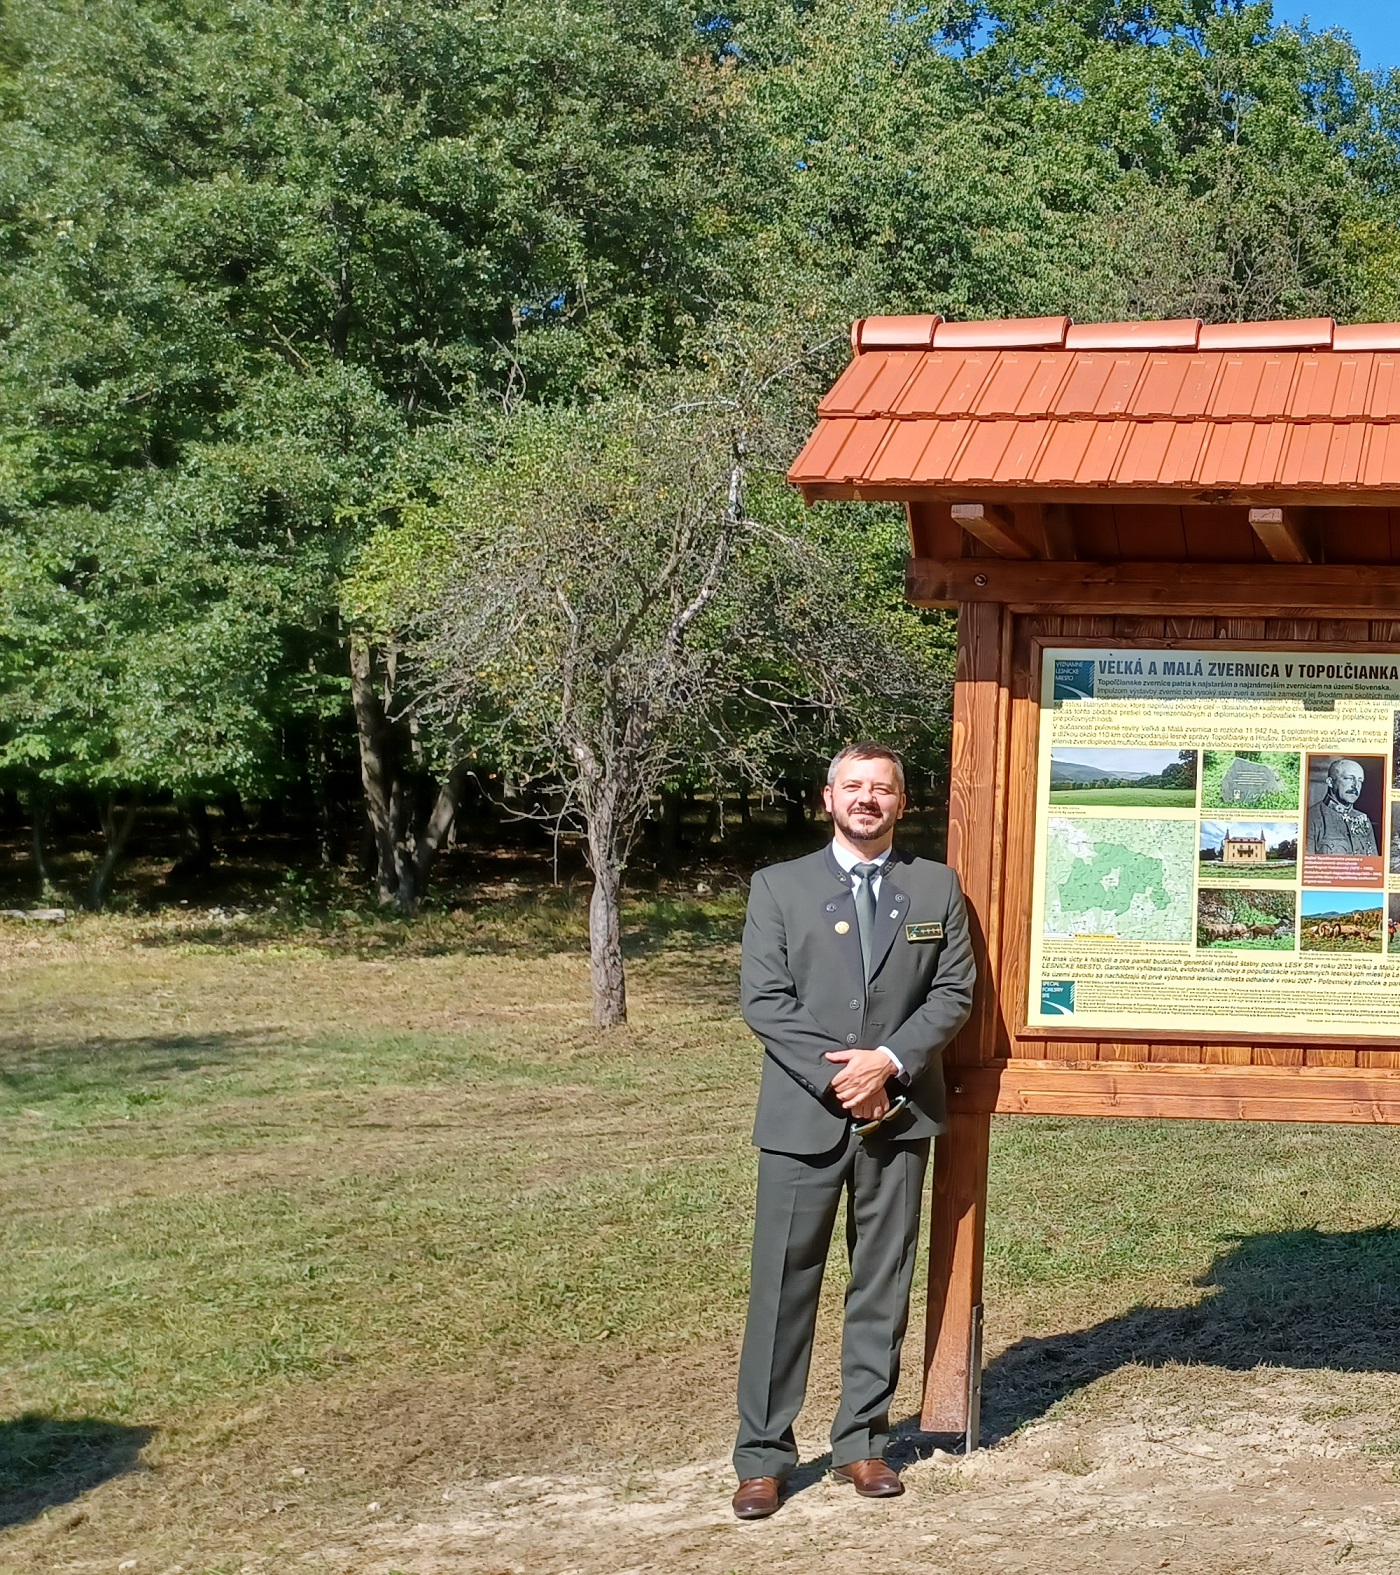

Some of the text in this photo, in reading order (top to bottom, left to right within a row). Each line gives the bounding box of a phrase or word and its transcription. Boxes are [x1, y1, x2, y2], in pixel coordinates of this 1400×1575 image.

[1098, 657, 1143, 675] VEĽKÁ
[1147, 661, 1157, 675] A
[1162, 658, 1203, 676] MALÁ
[1208, 662, 1279, 677] ZVERNICA
[1284, 663, 1293, 677] V
